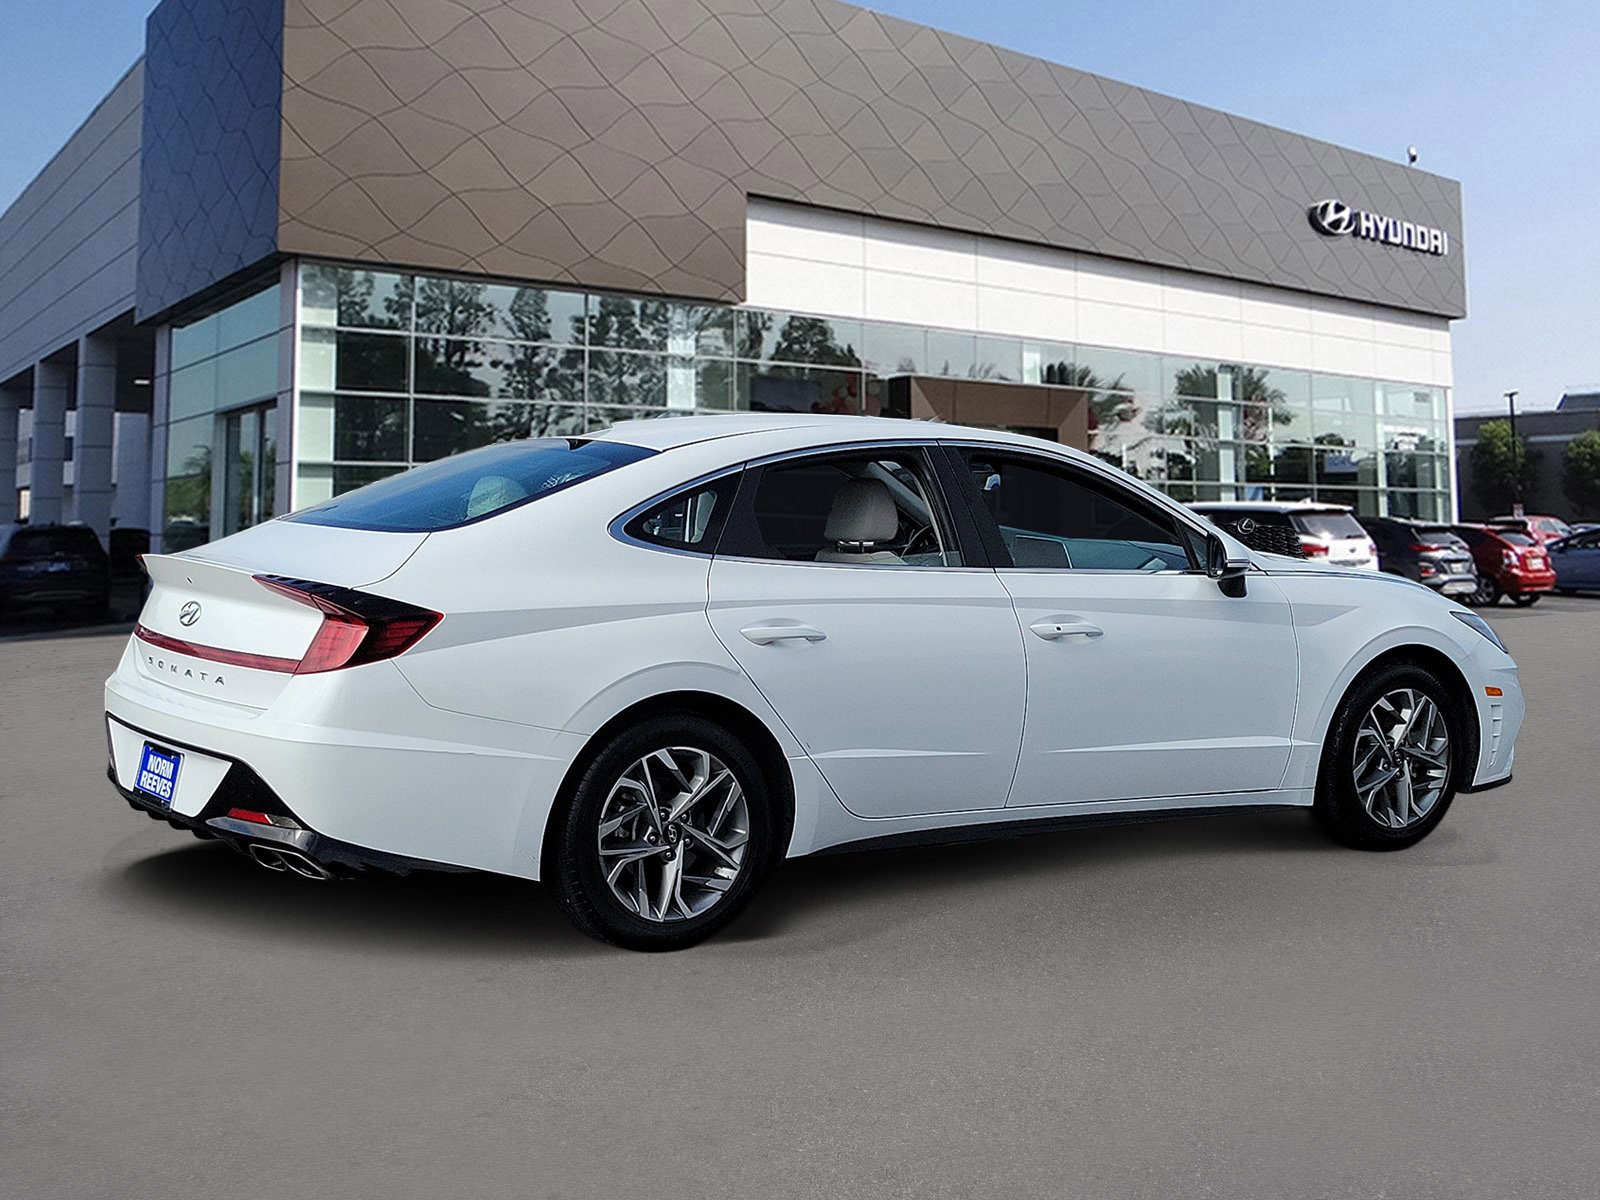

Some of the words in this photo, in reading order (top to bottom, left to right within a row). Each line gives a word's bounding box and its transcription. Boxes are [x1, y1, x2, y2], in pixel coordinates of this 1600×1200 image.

[1360, 211, 1449, 255] HYUNDAI
[147, 656, 225, 686] SONATA
[147, 753, 175, 780] NORM
[139, 769, 173, 799] REEVES
